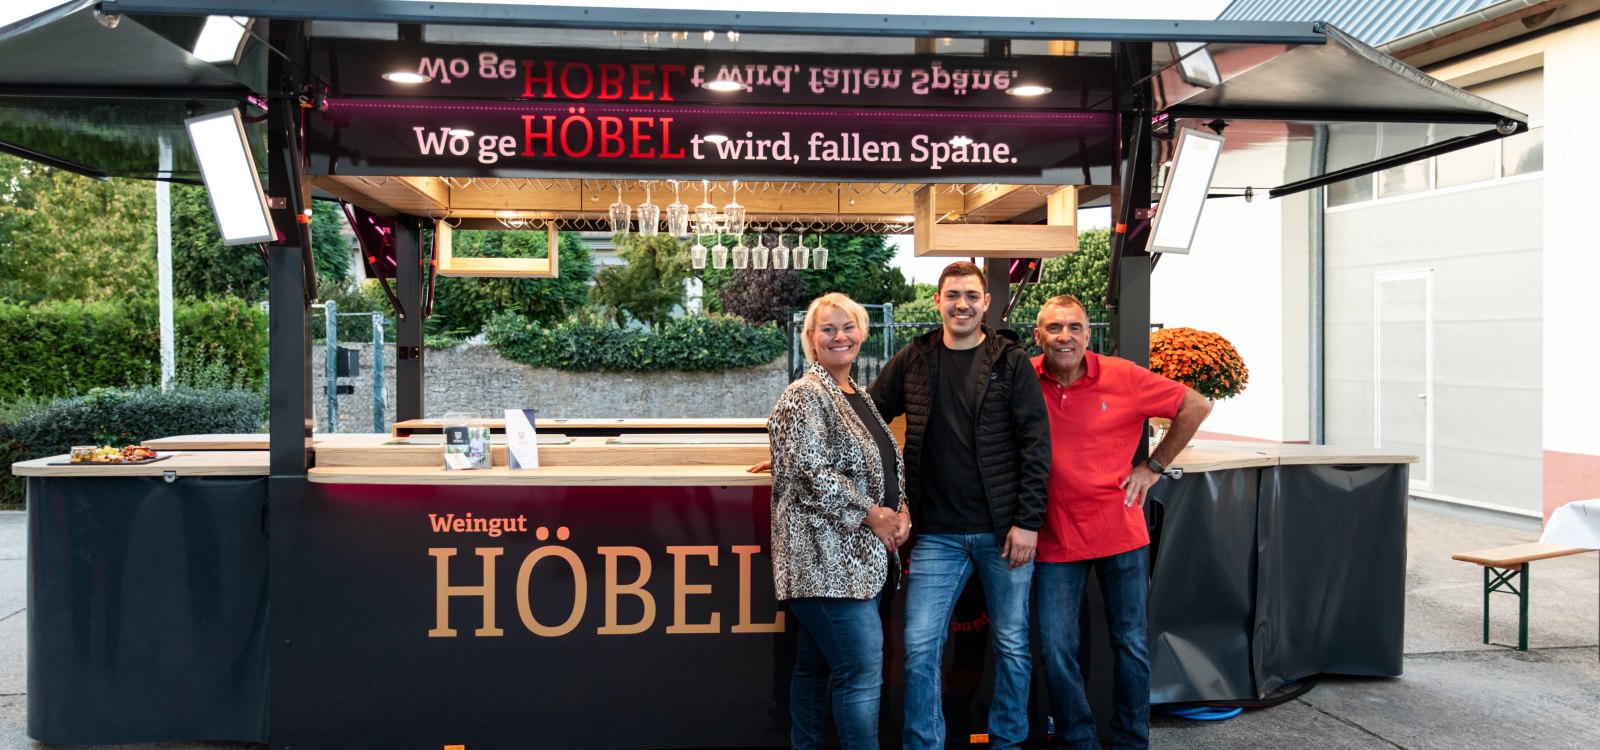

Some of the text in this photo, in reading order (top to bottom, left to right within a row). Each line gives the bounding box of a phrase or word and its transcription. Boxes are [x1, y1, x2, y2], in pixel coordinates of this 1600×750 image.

[413, 126, 470, 156] Wo
[716, 131, 799, 164] wird,
[808, 132, 902, 162] fallen
[910, 134, 1018, 169] Späne.
[428, 512, 527, 537] Weingut
[428, 526, 786, 637] HÖBEL
[951, 611, 991, 633] päne.
